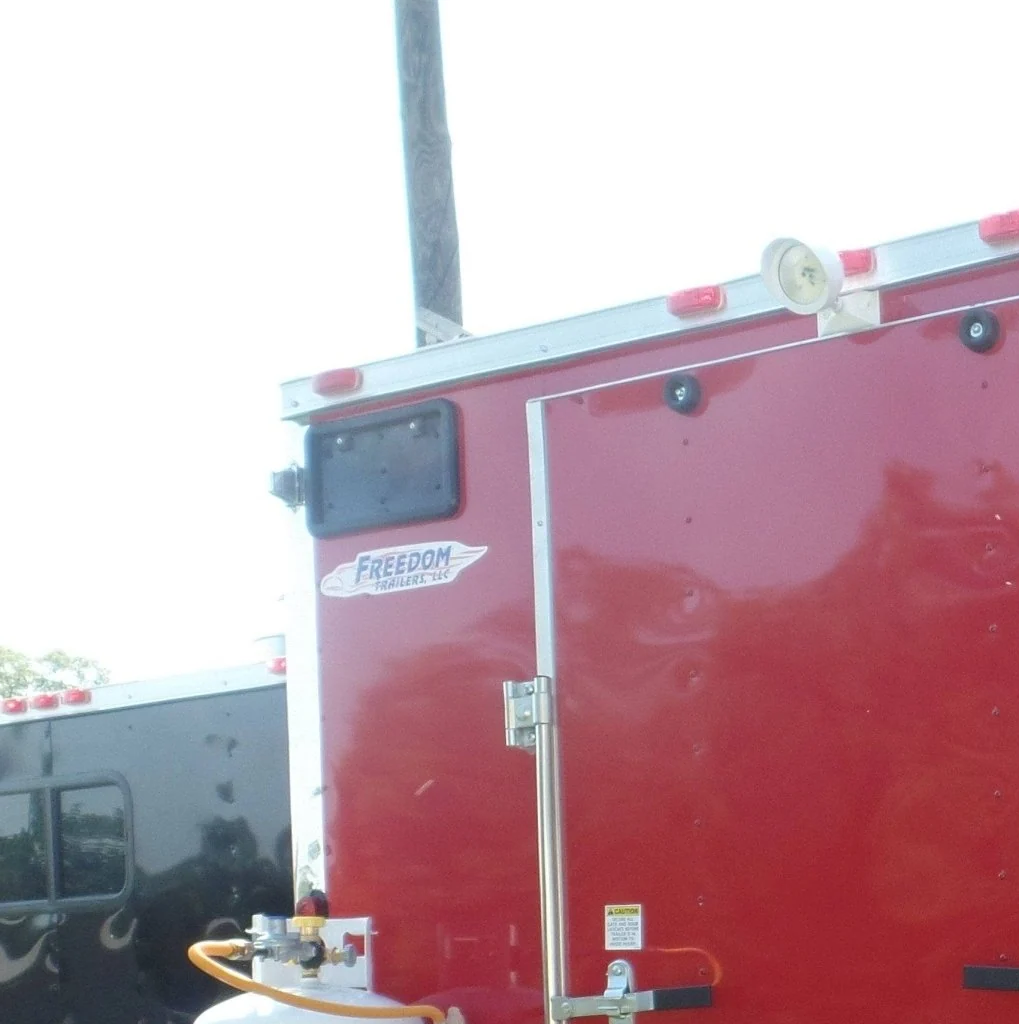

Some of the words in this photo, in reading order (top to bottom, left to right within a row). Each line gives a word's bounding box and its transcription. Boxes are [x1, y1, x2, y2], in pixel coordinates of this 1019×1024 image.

[355, 546, 451, 583] FREEDOM
[375, 575, 427, 591] TRAILERS,
[432, 569, 450, 581] LLC
